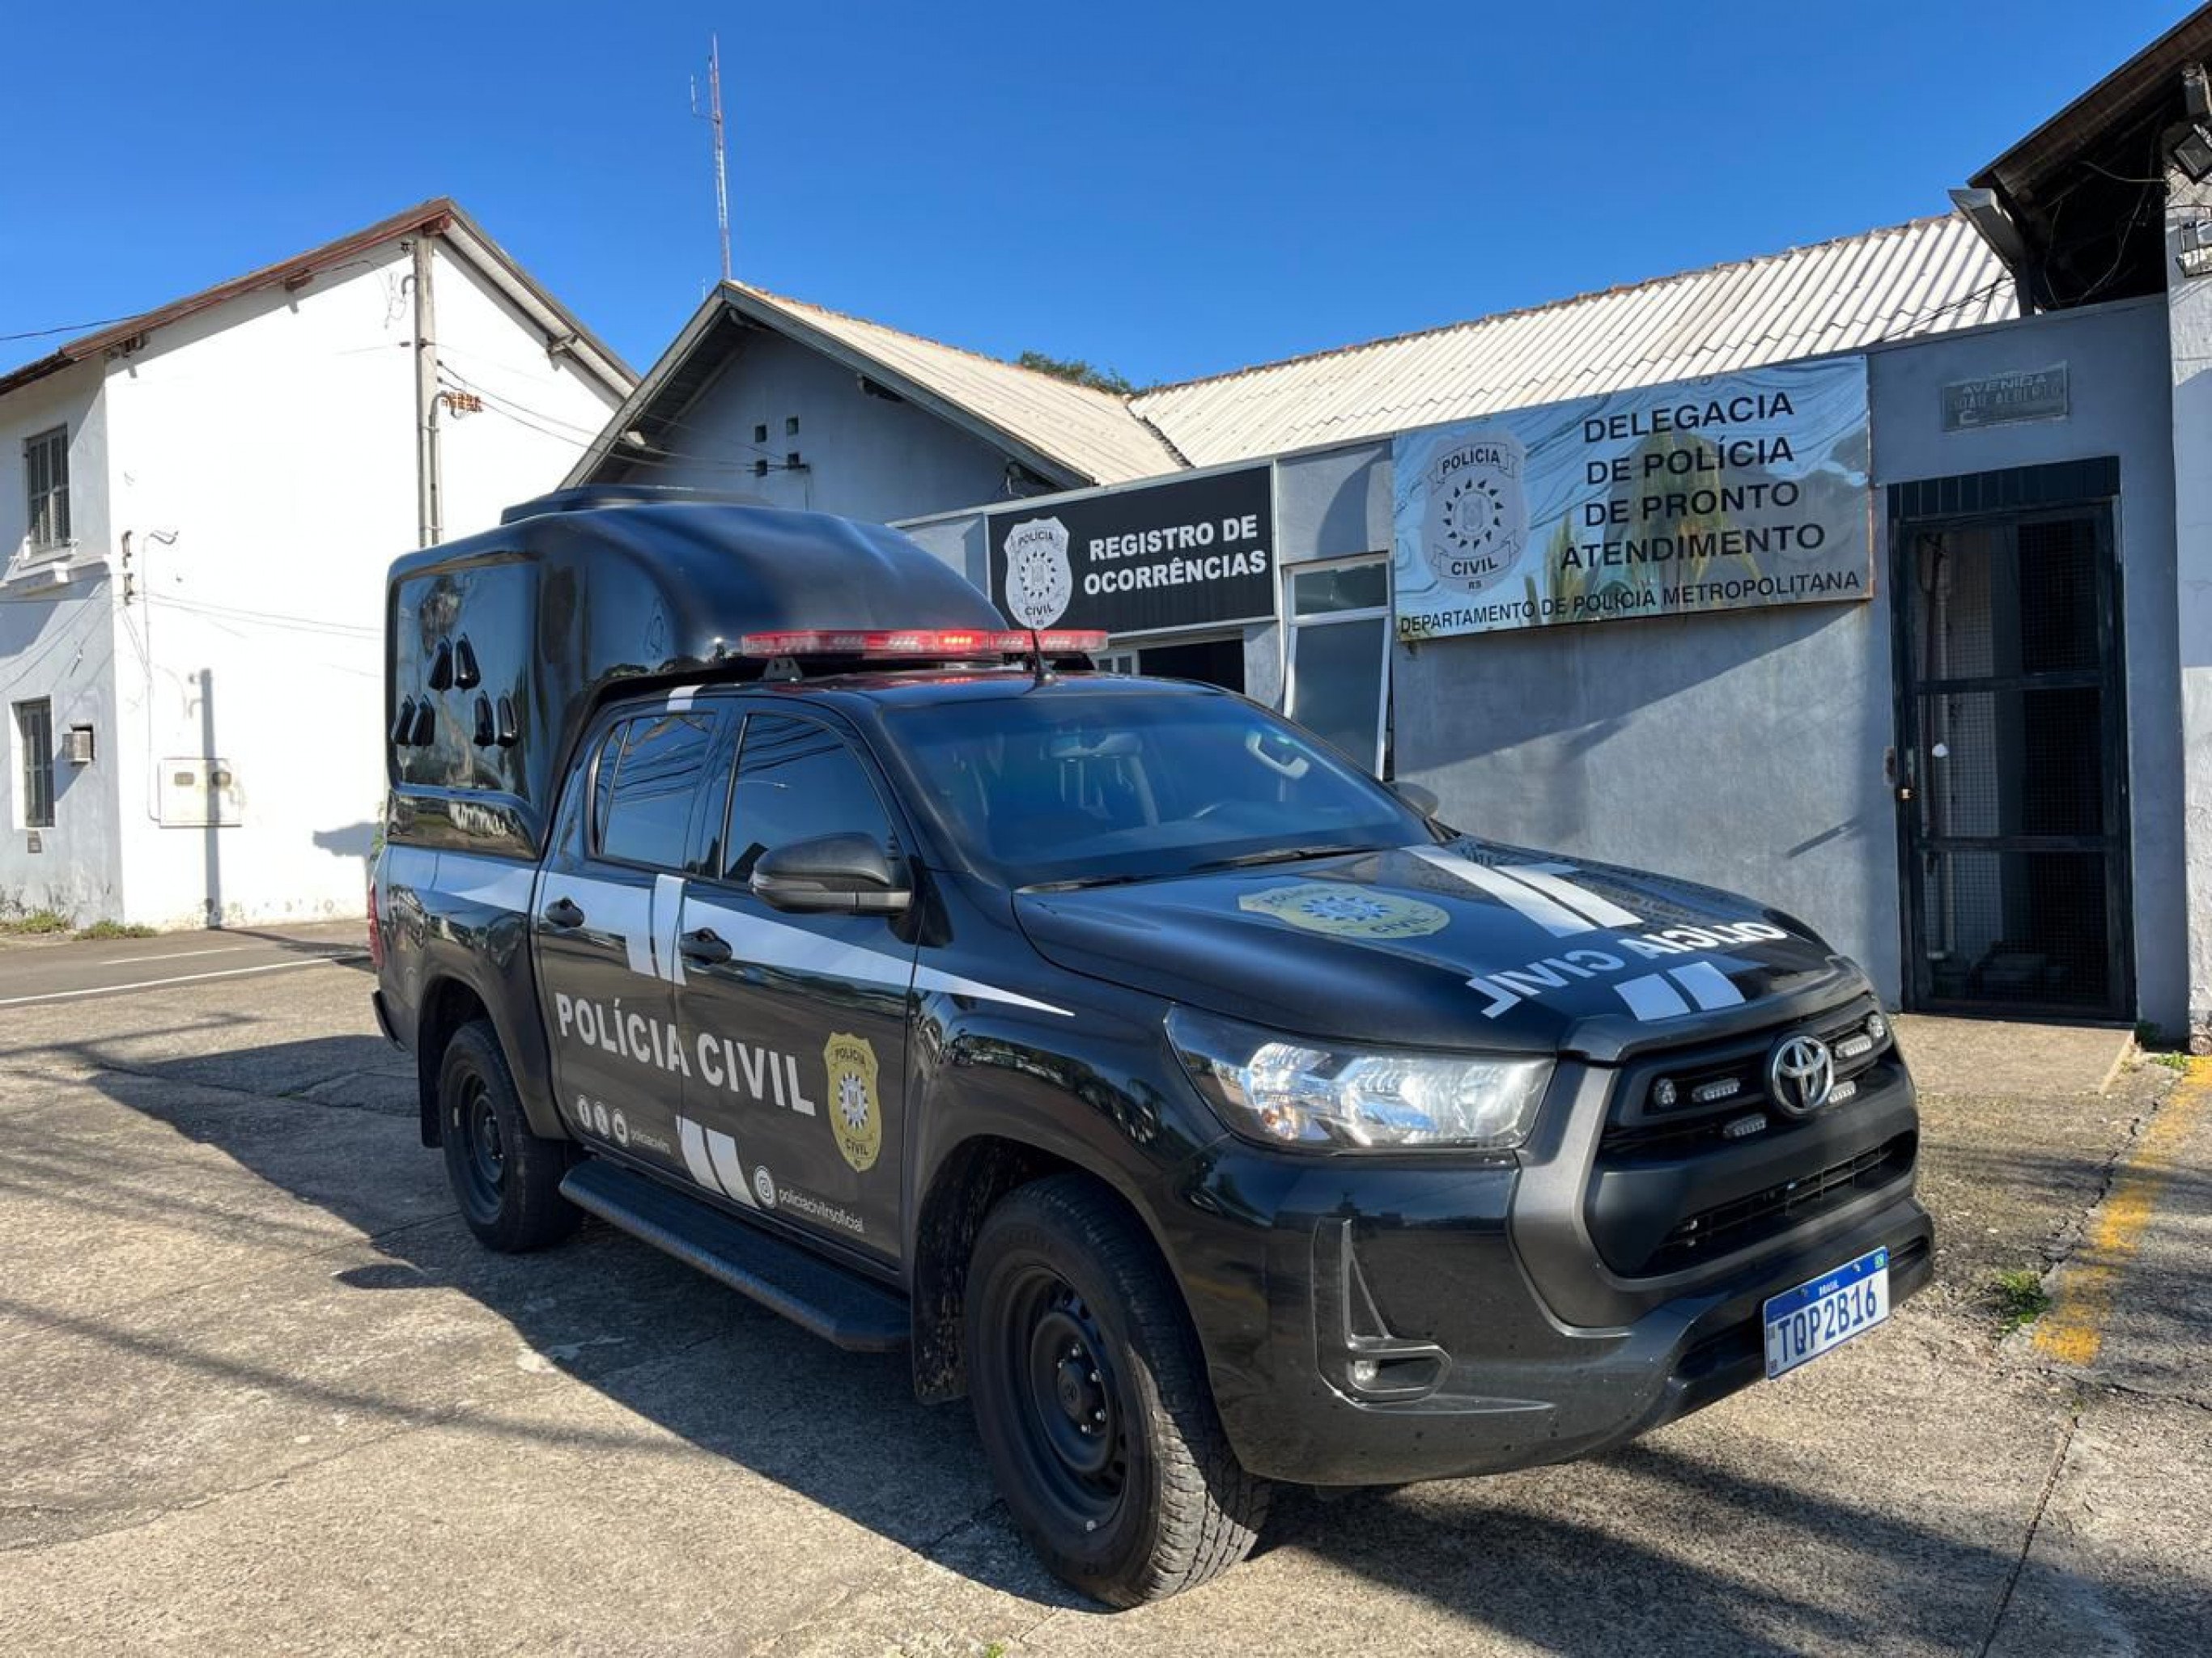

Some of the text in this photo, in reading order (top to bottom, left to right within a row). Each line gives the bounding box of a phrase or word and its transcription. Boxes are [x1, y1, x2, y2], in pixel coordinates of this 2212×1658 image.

[1584, 392, 1794, 443] DELEGACIA
[1587, 435, 1794, 484] DE POLÍCIA
[1586, 481, 1799, 527] DE PRONTO
[1089, 514, 1259, 562] REGISTRO DE
[1560, 523, 1825, 570] ATENDIMENTO
[1084, 550, 1267, 596] OCORRÊNCIAS
[1451, 557, 1499, 575] CIVIL
[1400, 600, 1535, 634] DEPARTAMENTO
[1541, 598, 1568, 617] DE
[1662, 570, 1861, 605] METROPOLITANA
[555, 992, 817, 1117] POLÍCIA CIVIL
[1778, 1278, 1877, 1363] TQP2B16
